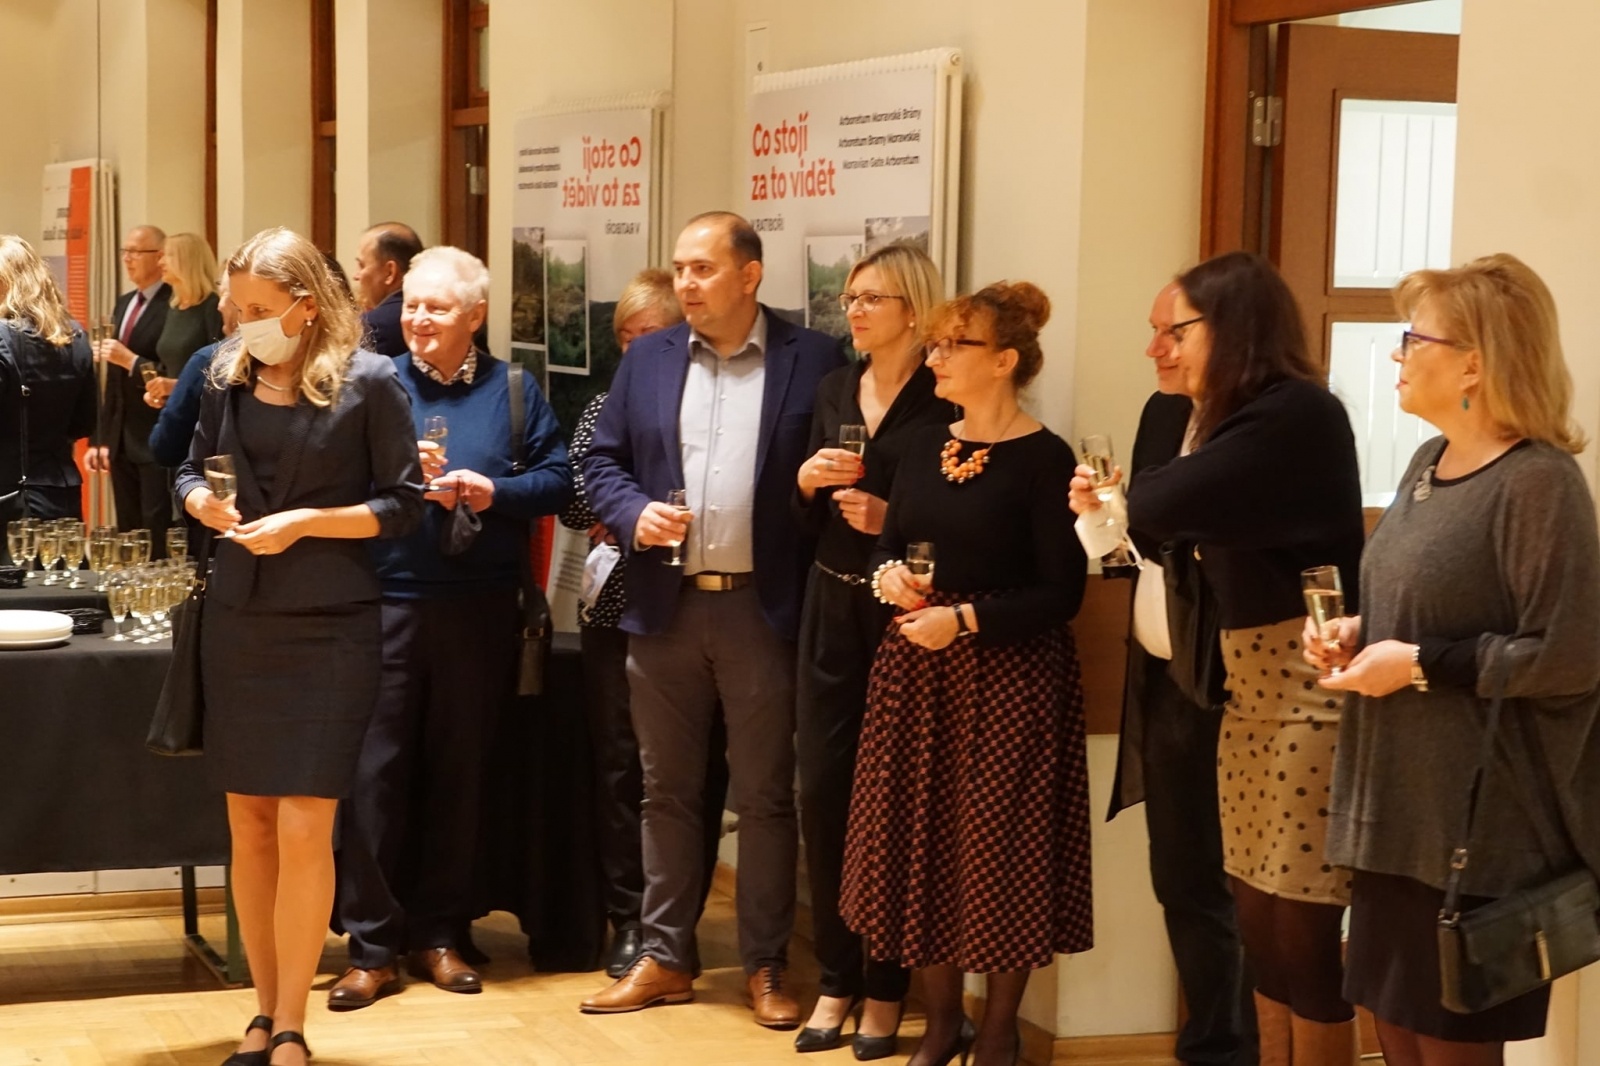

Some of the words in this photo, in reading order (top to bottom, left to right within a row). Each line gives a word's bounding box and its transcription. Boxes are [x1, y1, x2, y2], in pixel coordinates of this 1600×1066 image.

[753, 123, 771, 157] Co
[774, 110, 809, 158] stojí
[752, 174, 767, 200] za
[771, 165, 787, 199] to
[789, 158, 836, 198] vidět
